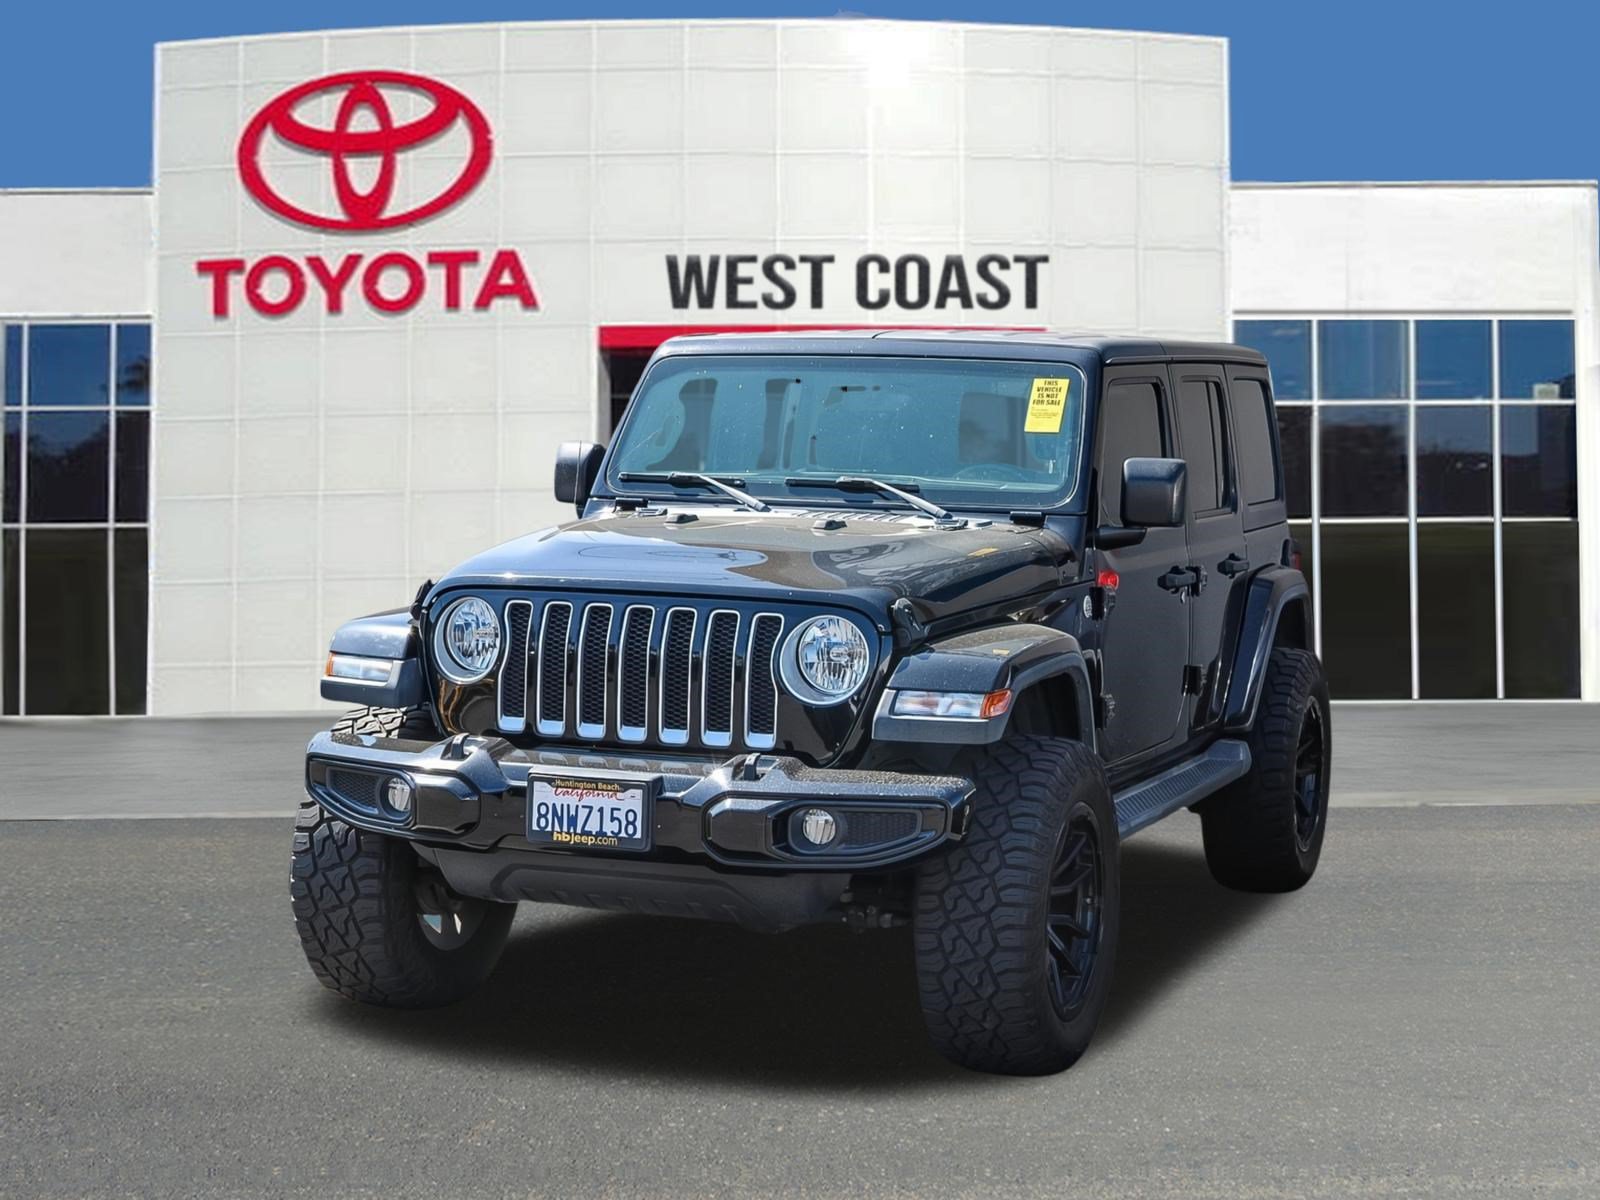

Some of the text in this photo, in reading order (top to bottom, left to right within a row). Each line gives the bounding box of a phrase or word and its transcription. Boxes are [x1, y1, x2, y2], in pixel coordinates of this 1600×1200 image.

[197, 249, 538, 317] TOYOTA
[666, 254, 1050, 310] WEST COAST
[555, 780, 620, 791] Huntington Beach
[536, 802, 638, 838] 8NWZ158
[552, 831, 618, 846] hbjeep.com
